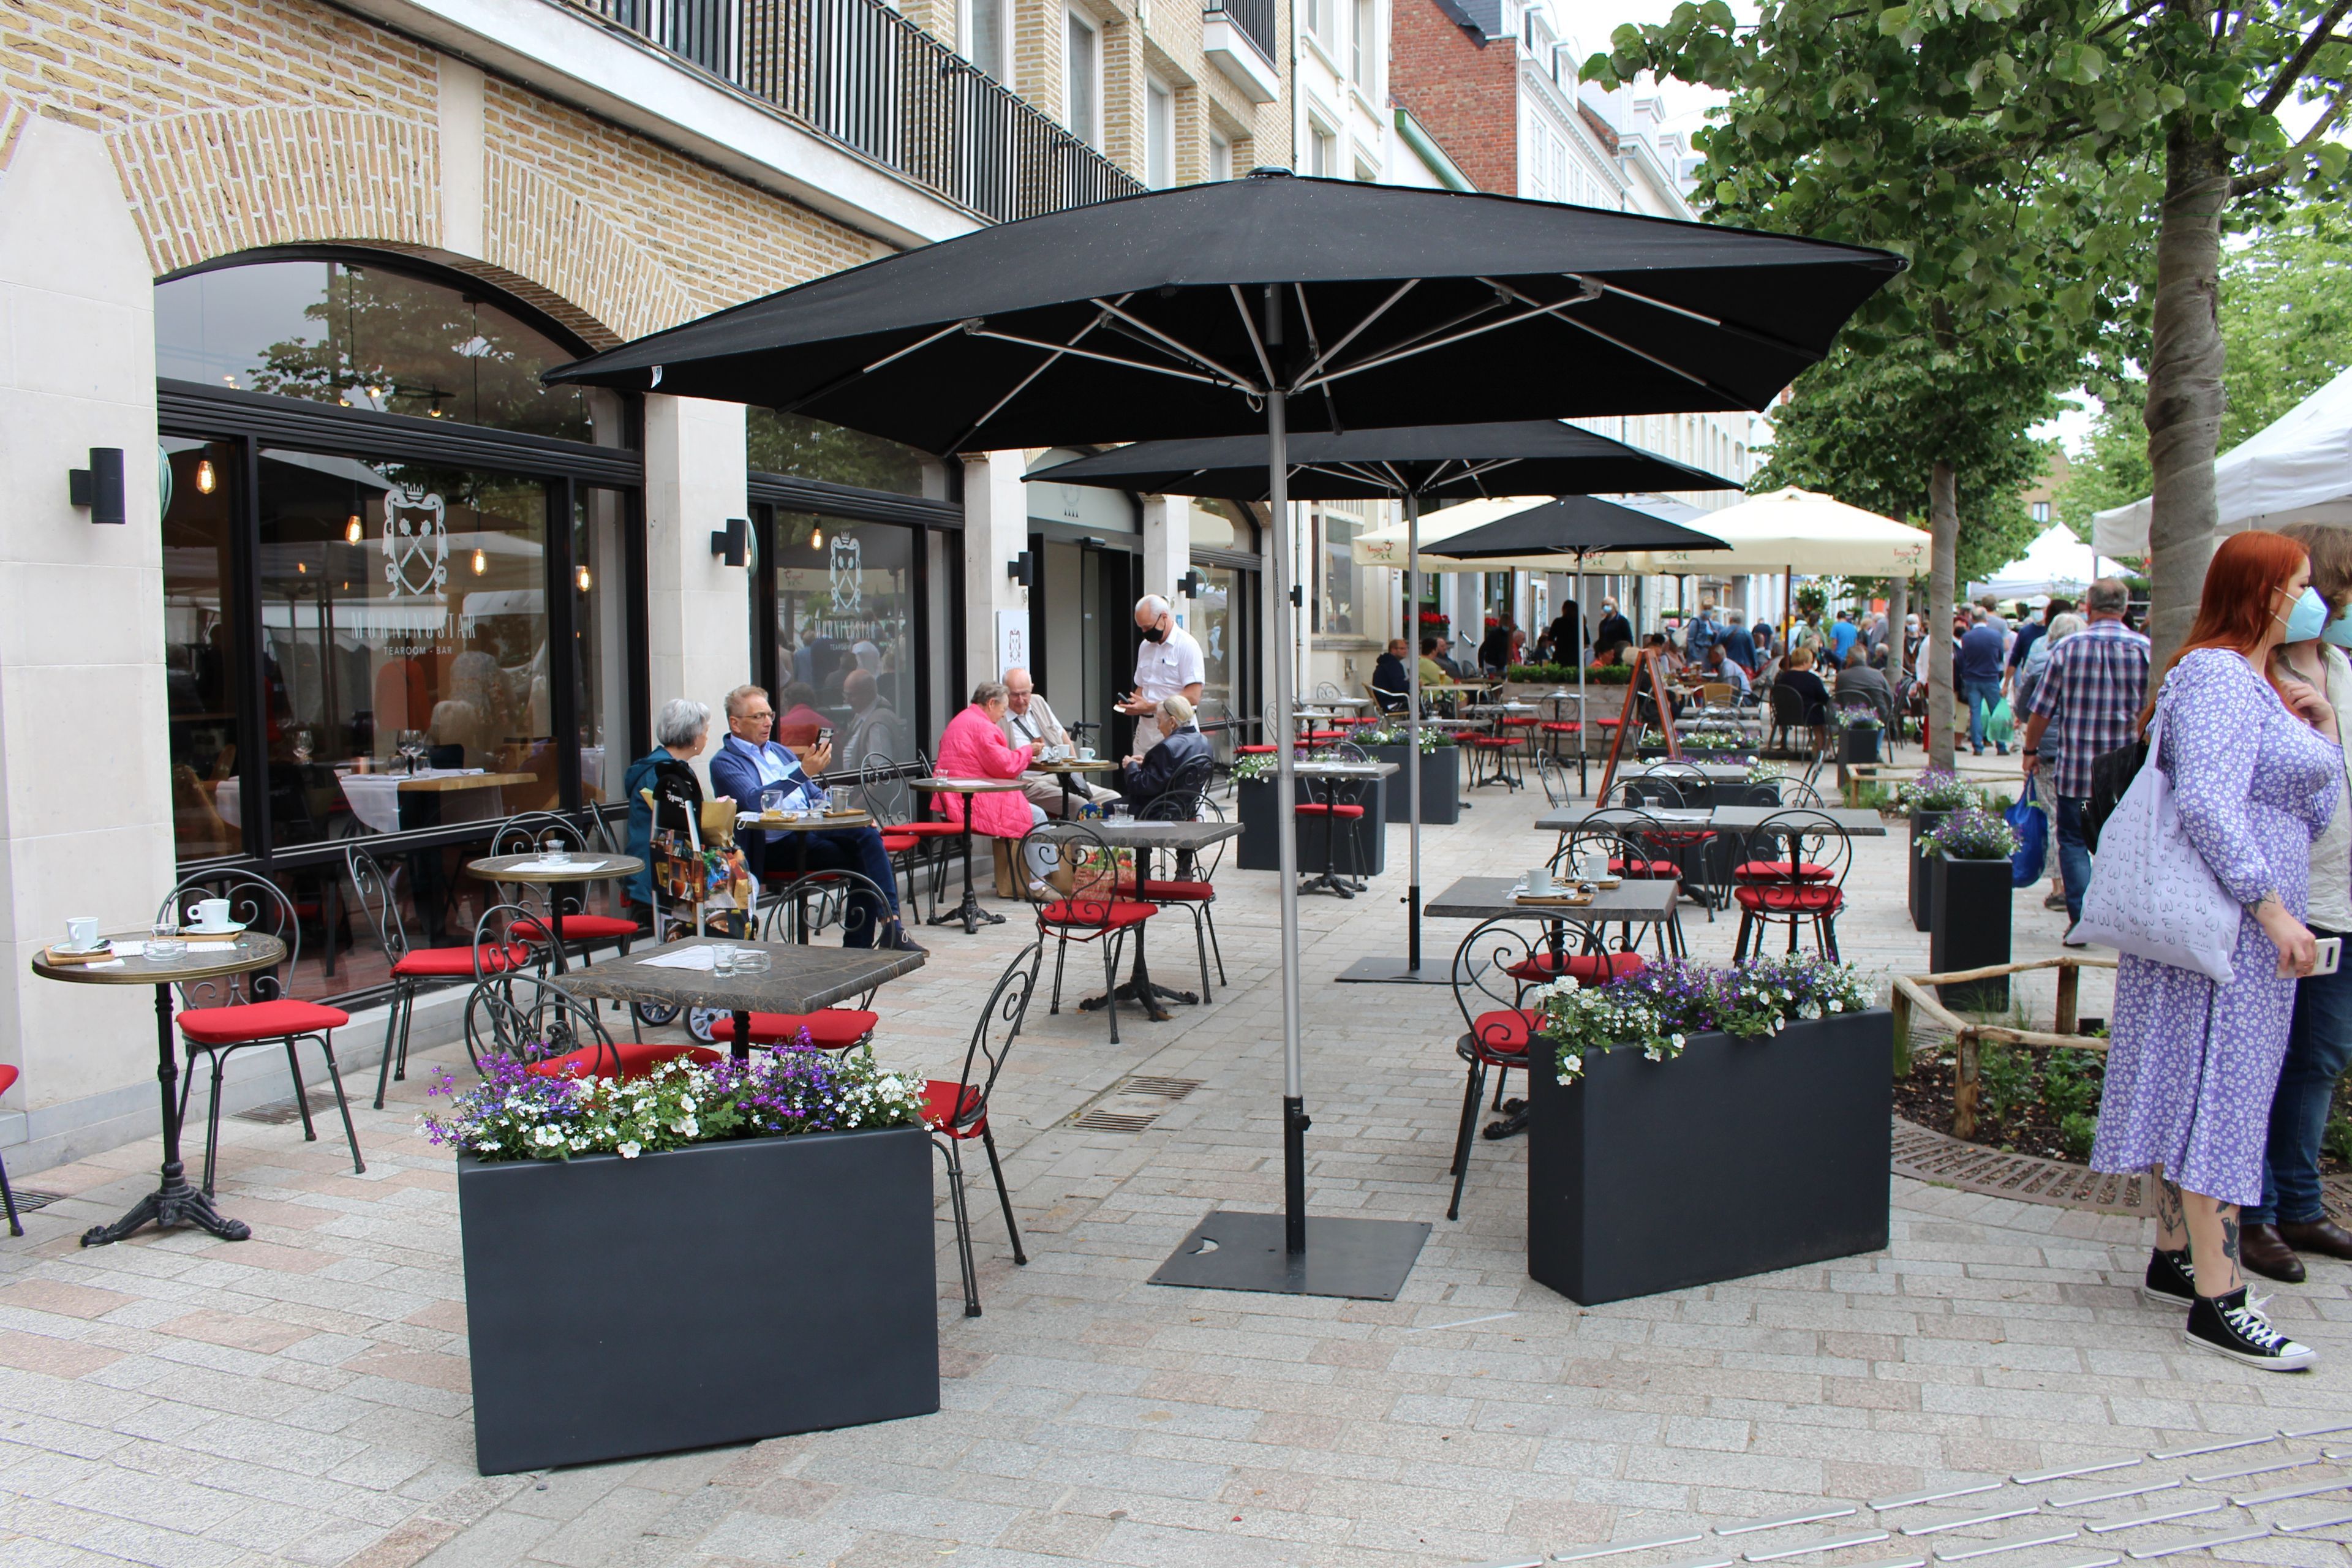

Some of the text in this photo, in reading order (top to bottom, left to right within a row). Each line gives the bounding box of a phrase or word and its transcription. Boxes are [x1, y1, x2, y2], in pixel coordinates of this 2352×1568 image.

[351, 611, 476, 639] MORNINGSTAR
[383, 646, 426, 655] TEAROOM
[436, 646, 453, 655] BAR
